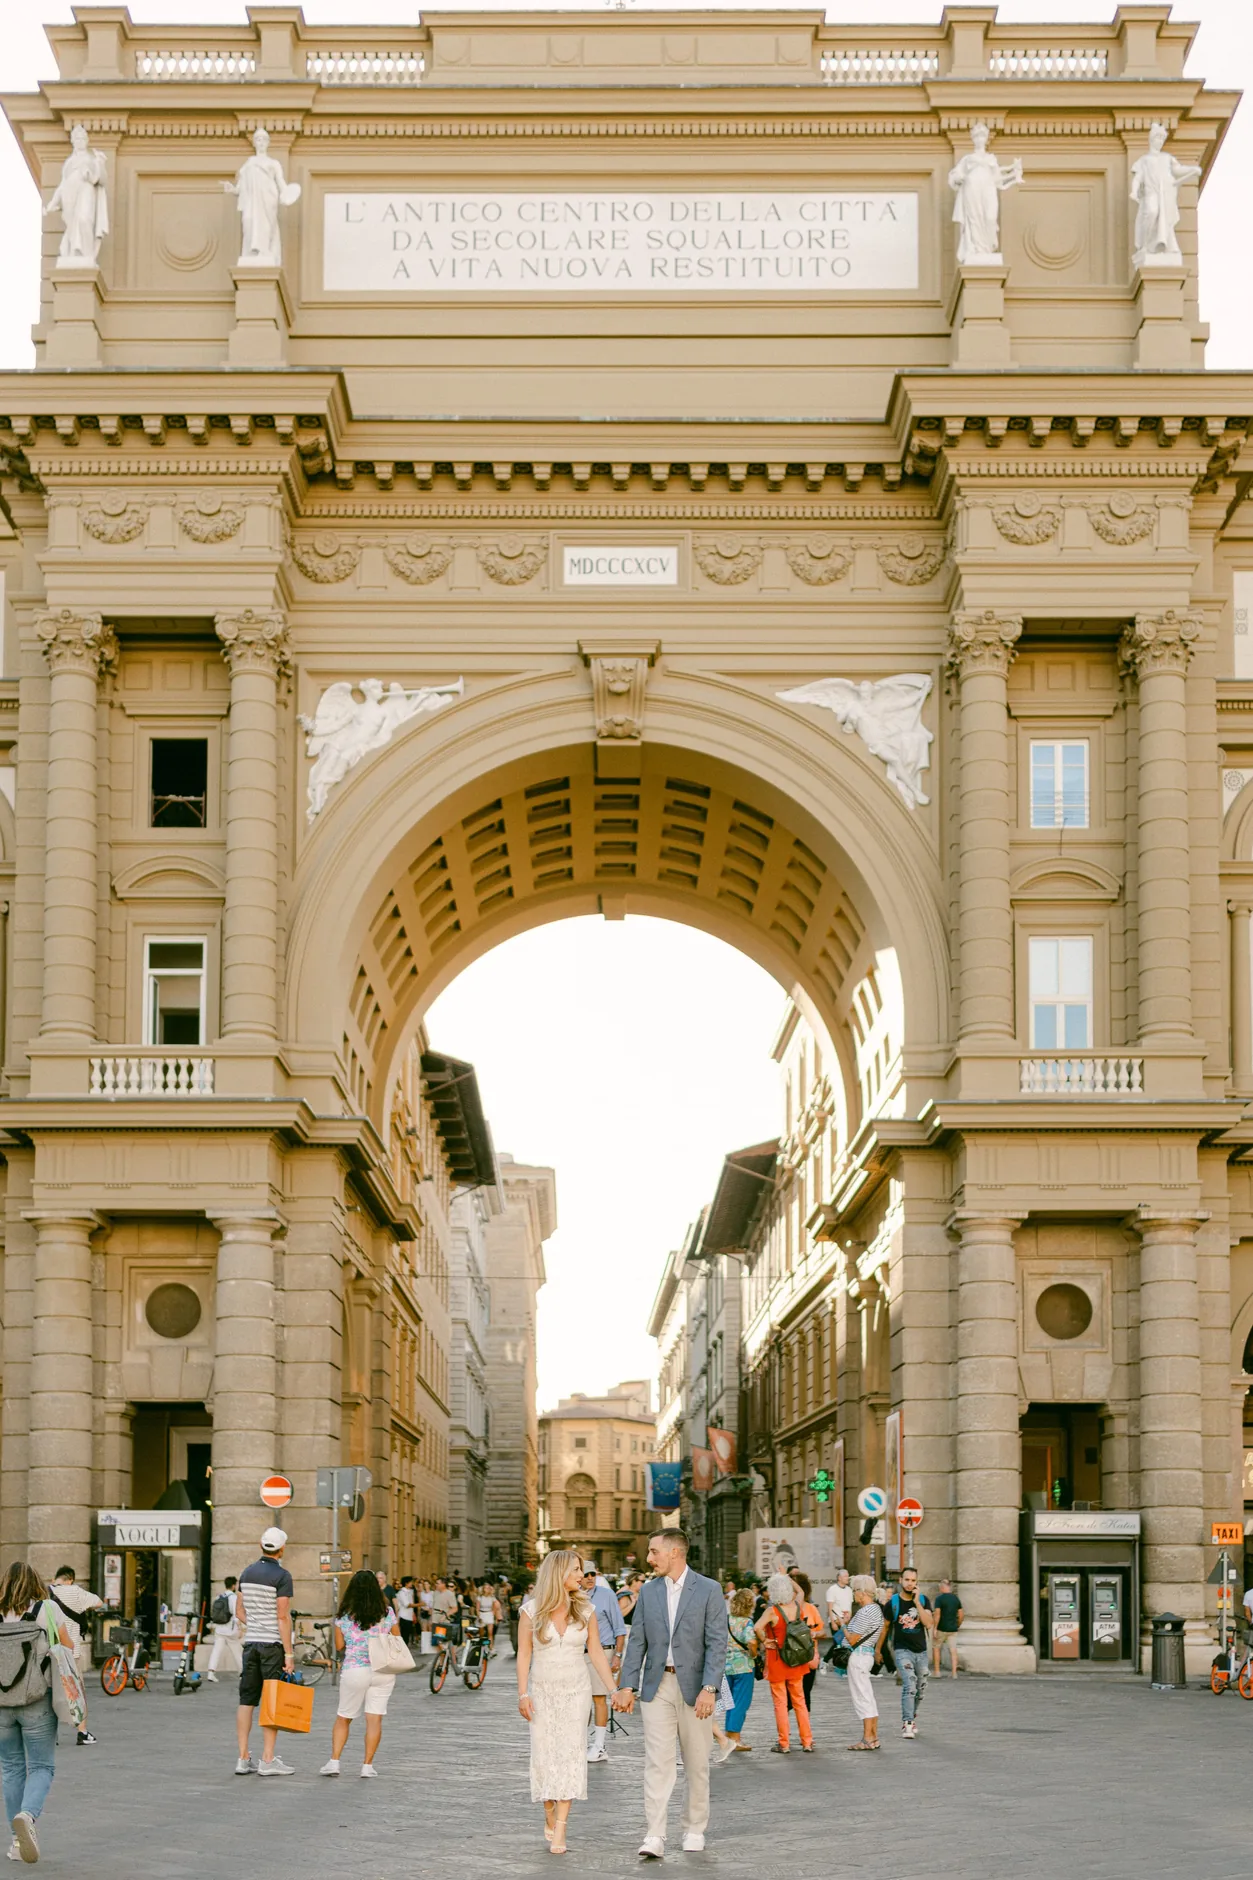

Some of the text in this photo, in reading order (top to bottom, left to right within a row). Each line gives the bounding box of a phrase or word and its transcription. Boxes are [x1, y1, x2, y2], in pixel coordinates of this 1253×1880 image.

[381, 201, 502, 222] ANTICO
[518, 201, 654, 222] CENTRO
[670, 201, 782, 222] DELLA
[799, 200, 898, 221] CITTÀ
[393, 229, 850, 252] DA SECOLARE SQUALLORE
[393, 257, 851, 279] A VITA NUOVA RESTITUITO
[569, 557, 670, 575] MDCCCXCV
[119, 1528, 178, 1543] VOGUE
[1216, 1528, 1238, 1539] TAXI
